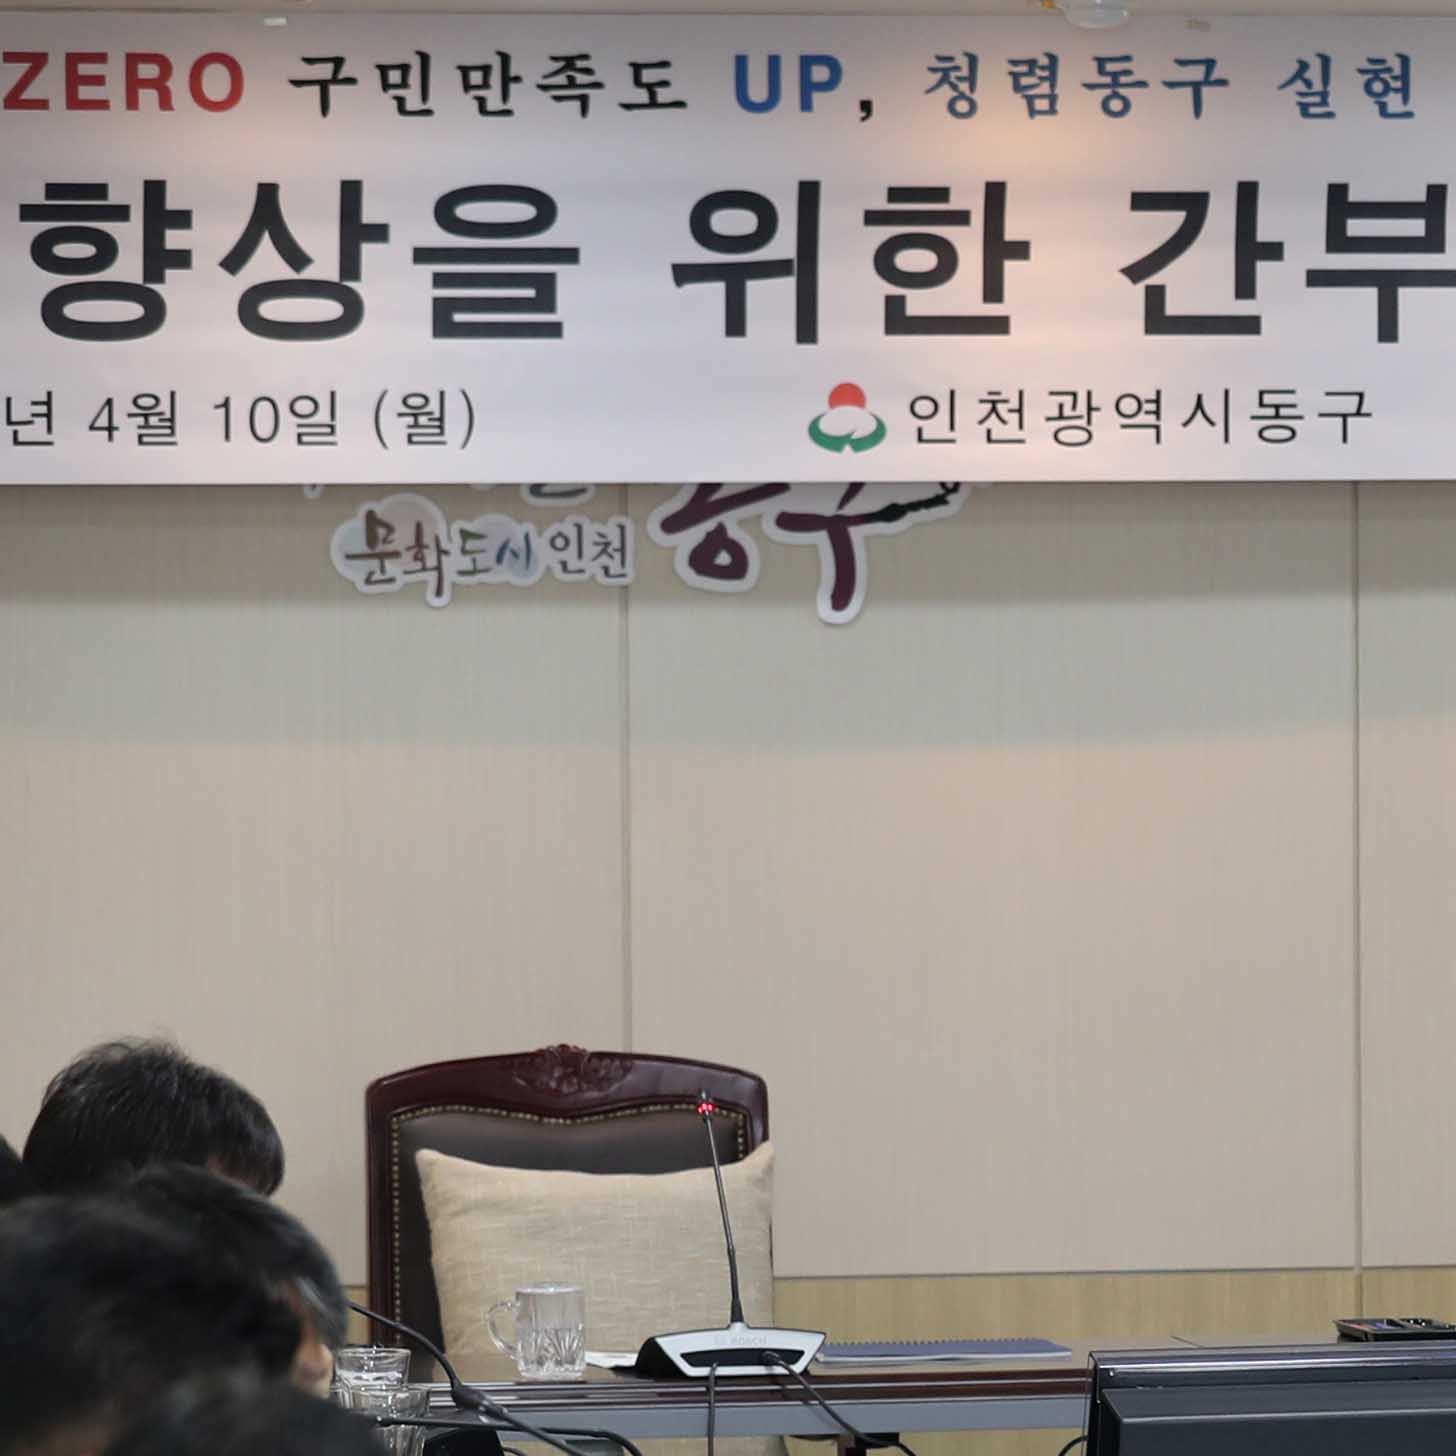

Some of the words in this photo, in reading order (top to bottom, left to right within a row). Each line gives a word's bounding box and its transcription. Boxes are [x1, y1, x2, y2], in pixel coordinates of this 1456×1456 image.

[2, 51, 244, 113] ZERO
[287, 50, 689, 119] 구민만족도
[734, 54, 873, 122] UP,
[924, 51, 1229, 120] 청렴동구
[1277, 52, 1415, 119] 실현
[18, 178, 581, 343] 향상을
[670, 179, 1032, 346] 위한
[88, 389, 179, 447] 4월
[212, 389, 339, 447] 10일
[374, 389, 476, 451] (월)
[909, 387, 1374, 448] 인천광역시동구
